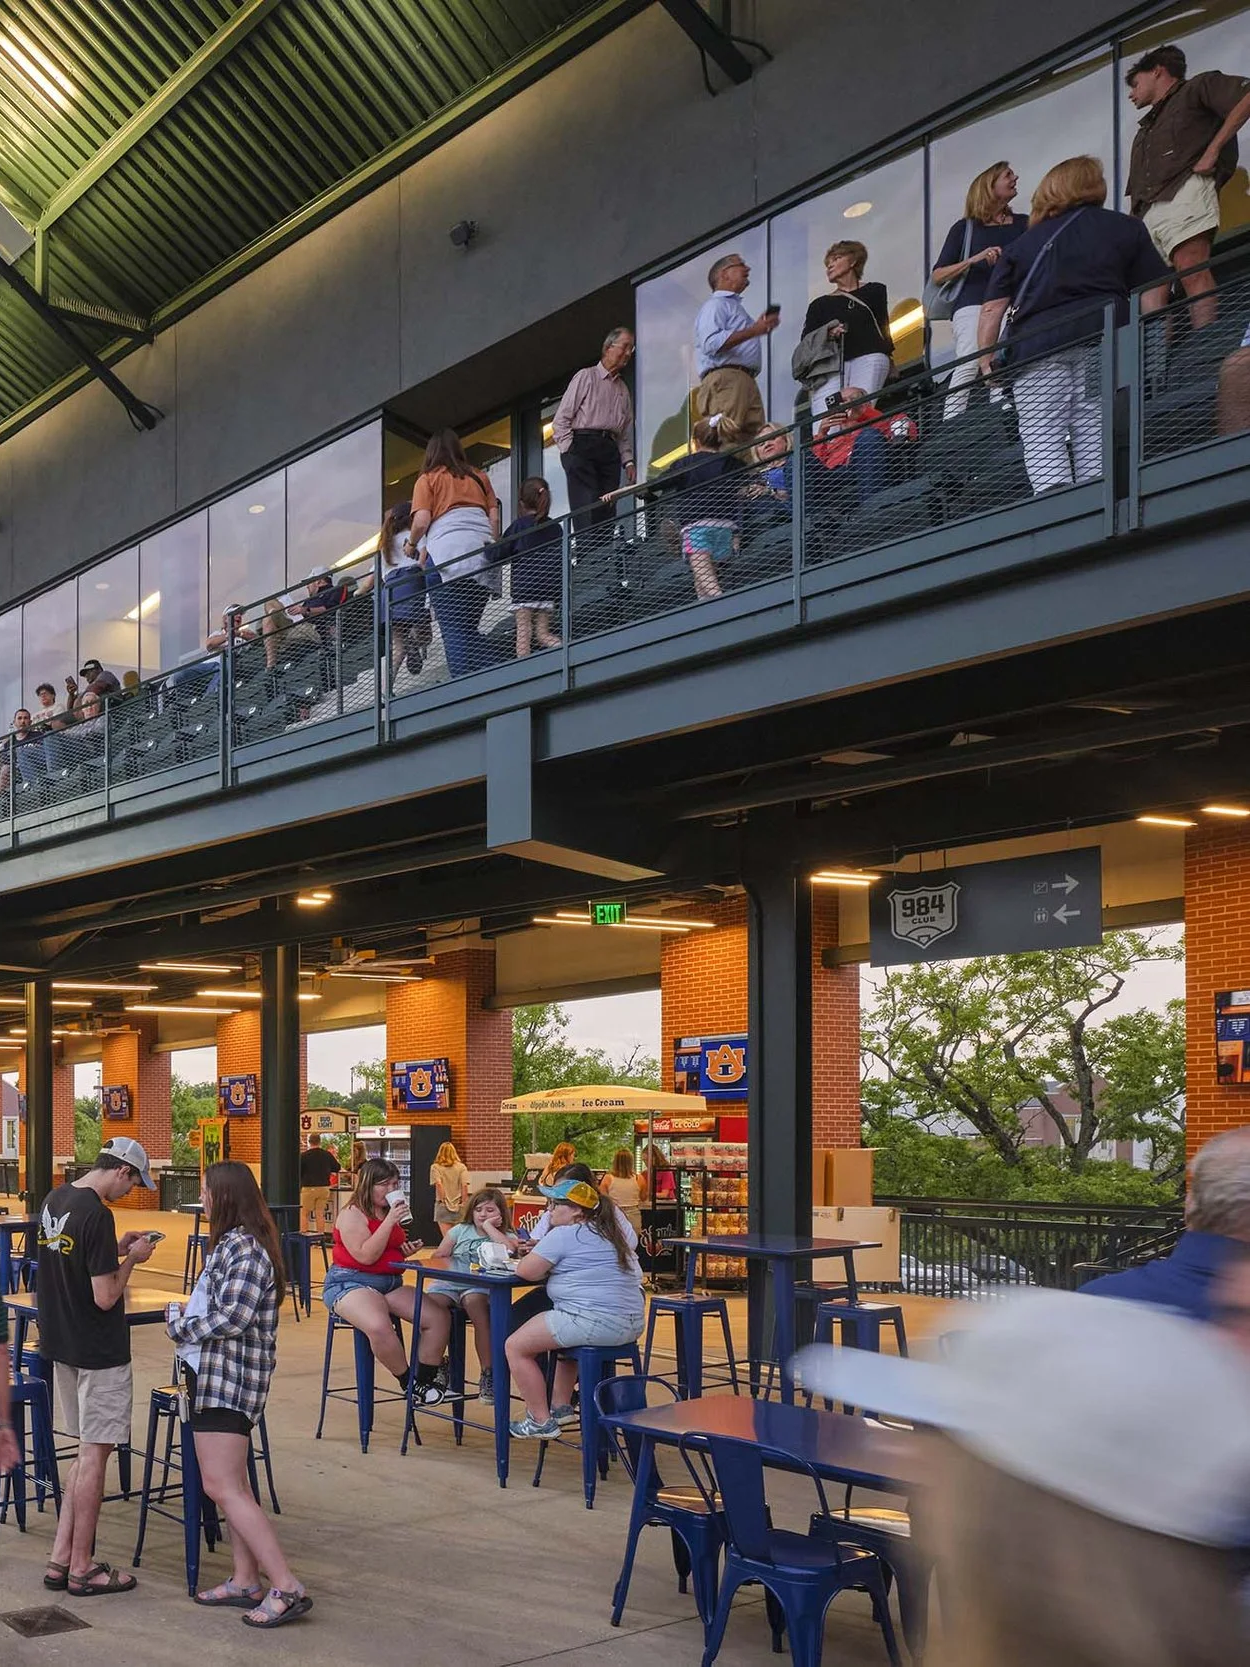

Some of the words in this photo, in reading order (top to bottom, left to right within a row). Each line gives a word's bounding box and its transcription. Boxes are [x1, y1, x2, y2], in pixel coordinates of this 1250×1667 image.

[902, 895, 945, 918] 984
[596, 904, 621, 924] EXIT
[912, 916, 935, 924] CLUB
[582, 1099, 593, 1107] Ice
[595, 1099, 624, 1107] Cream
